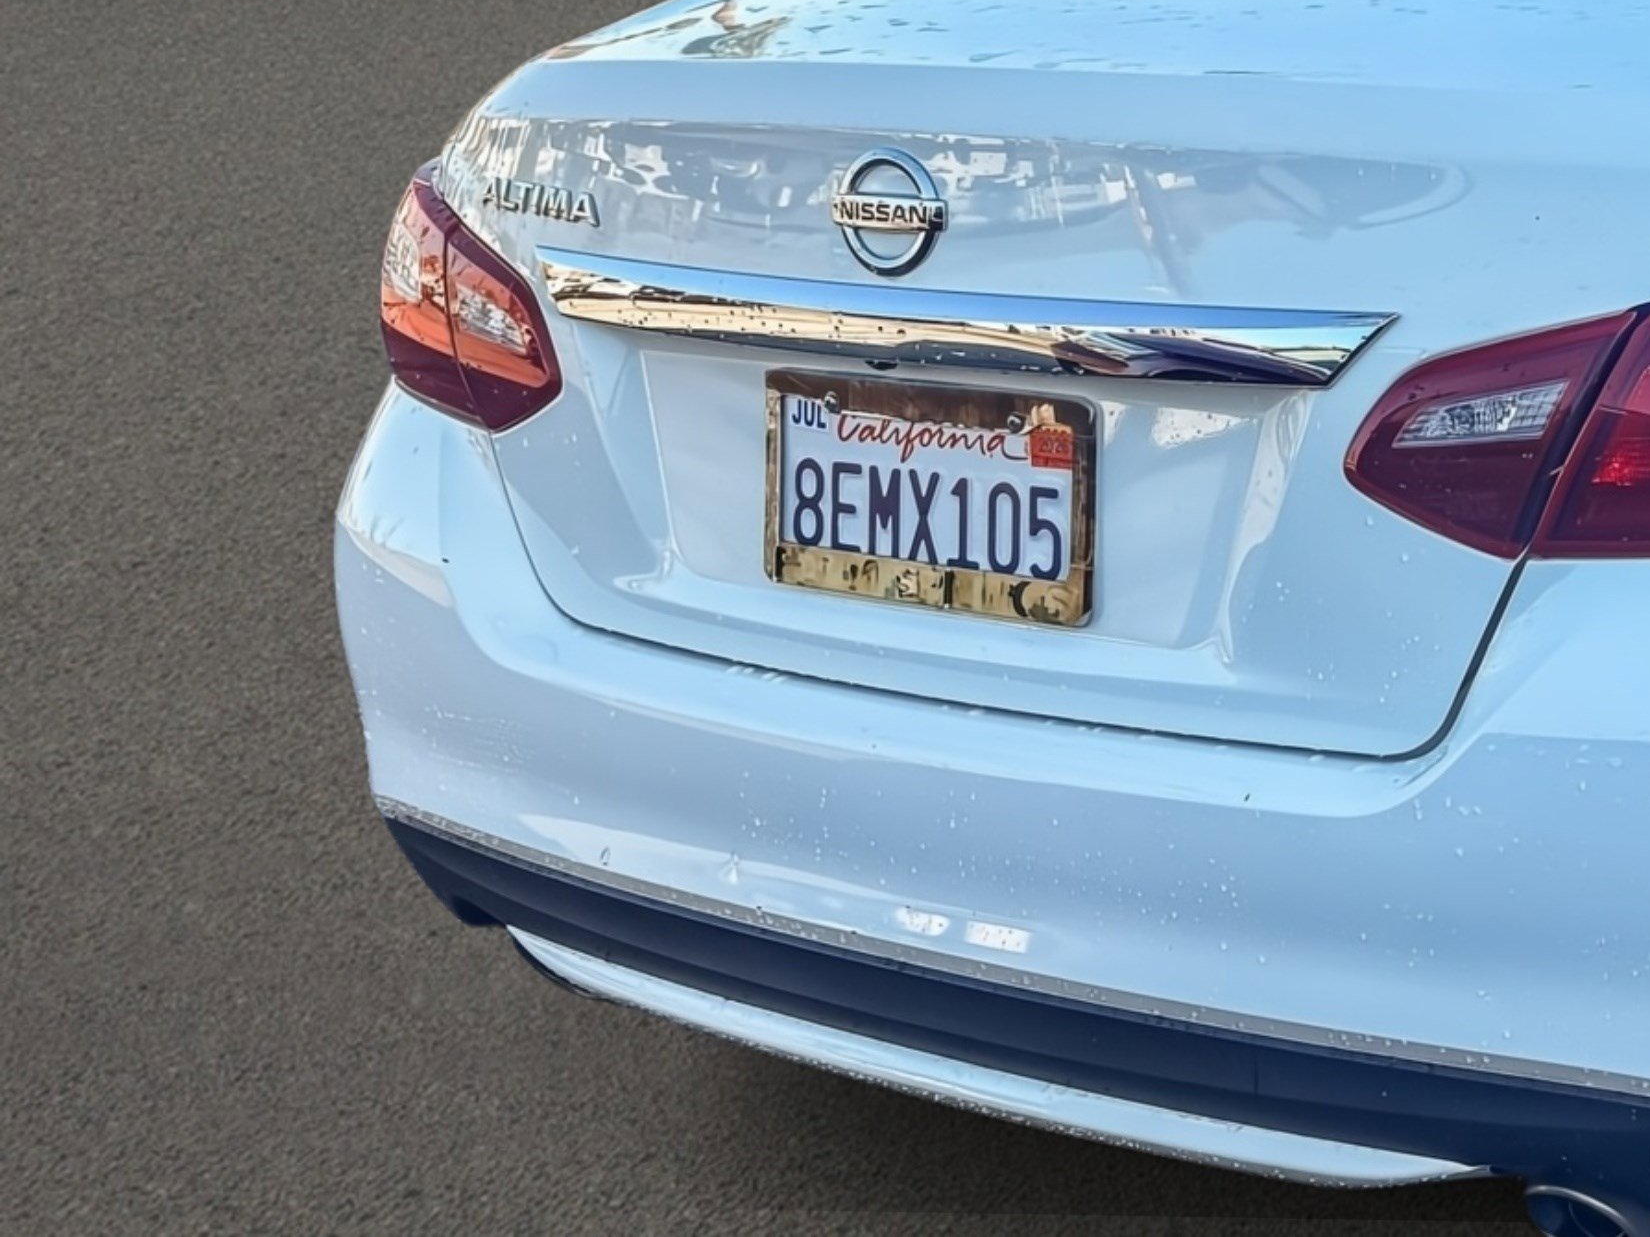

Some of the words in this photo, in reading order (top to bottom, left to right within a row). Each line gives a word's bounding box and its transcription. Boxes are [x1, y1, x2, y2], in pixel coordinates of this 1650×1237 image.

[482, 177, 601, 227] ALTIMA
[839, 200, 928, 224] NISSAN
[792, 398, 828, 428] JUL
[837, 413, 1030, 464] California
[793, 458, 1064, 581] 8EMX105
